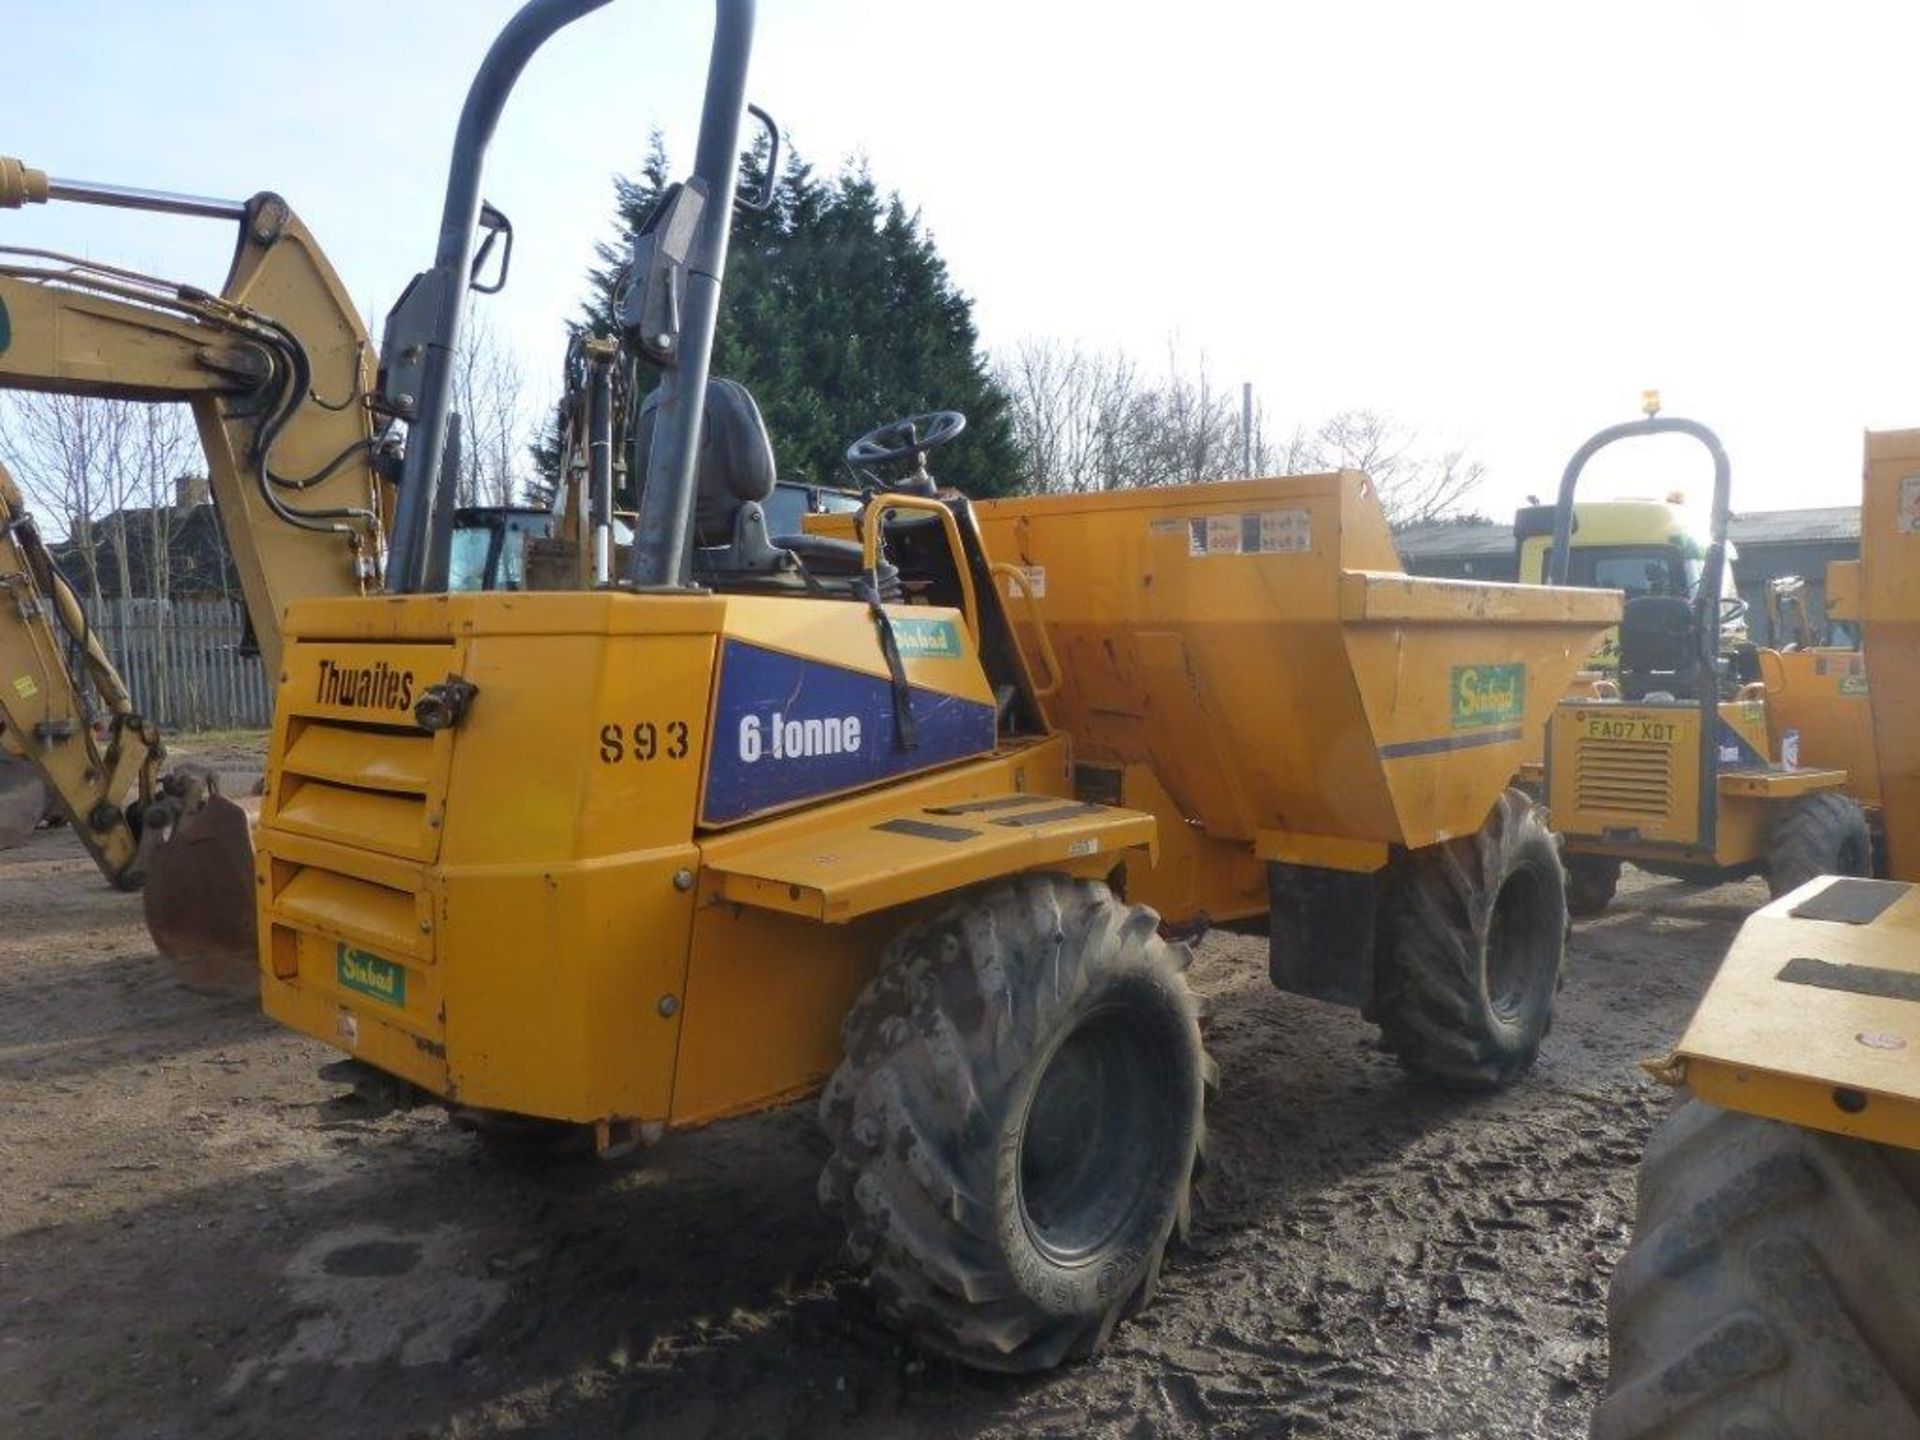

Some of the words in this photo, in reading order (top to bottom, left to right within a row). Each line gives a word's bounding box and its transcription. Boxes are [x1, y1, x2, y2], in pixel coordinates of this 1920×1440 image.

[892, 622, 949, 650] inbad
[317, 660, 414, 711] Thwaites
[1459, 668, 1514, 716] Sinbad
[600, 720, 689, 764] S93
[739, 714, 762, 763] 6
[772, 712, 861, 760] tonne
[1589, 721, 1635, 738] FA07
